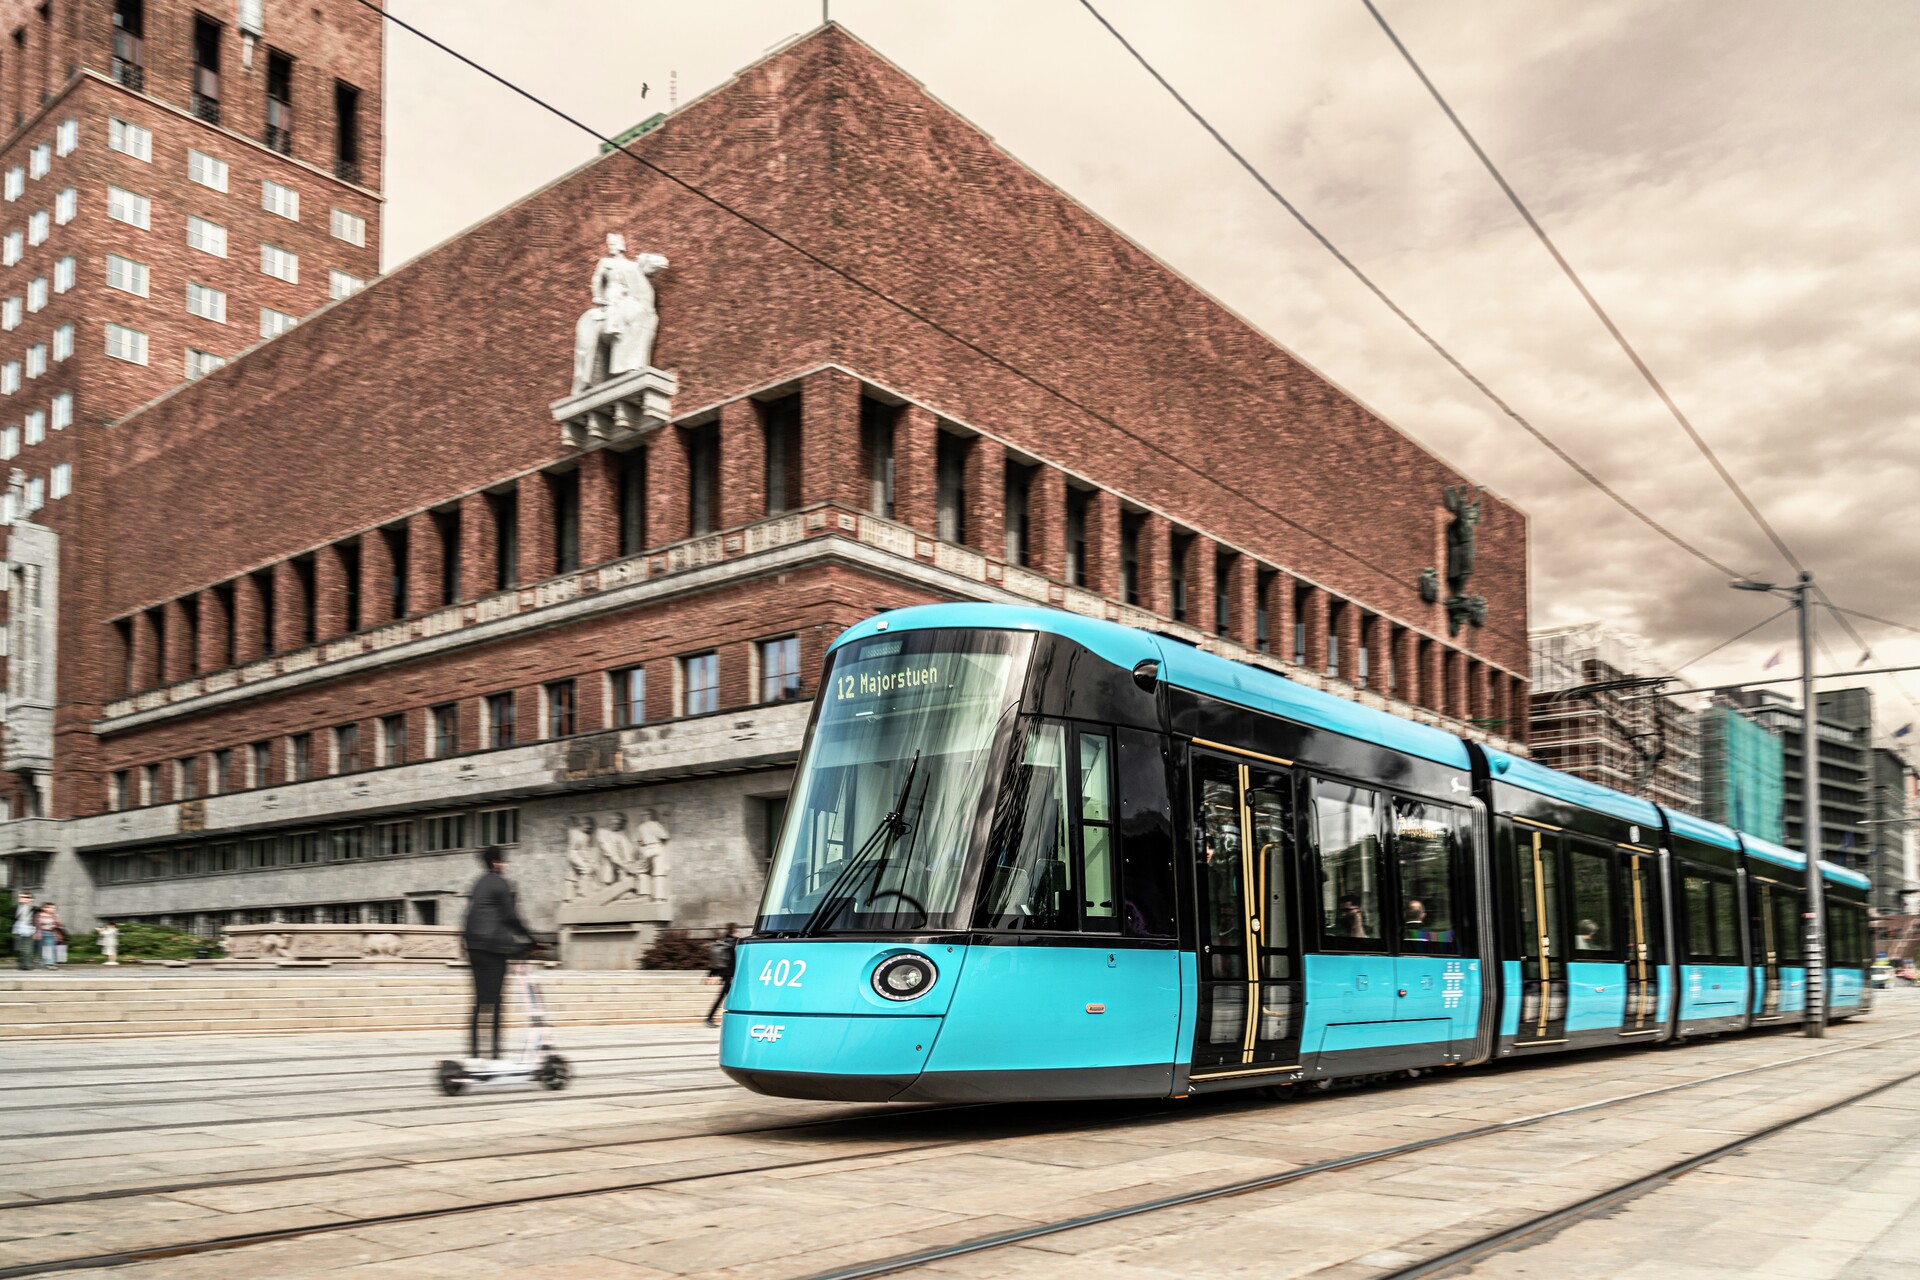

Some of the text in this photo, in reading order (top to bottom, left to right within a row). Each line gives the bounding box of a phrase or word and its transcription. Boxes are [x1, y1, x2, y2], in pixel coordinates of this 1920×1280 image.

[837, 667, 938, 700] 12 Majorstuen
[758, 959, 807, 987] 402
[750, 1024, 785, 1043] CAF
